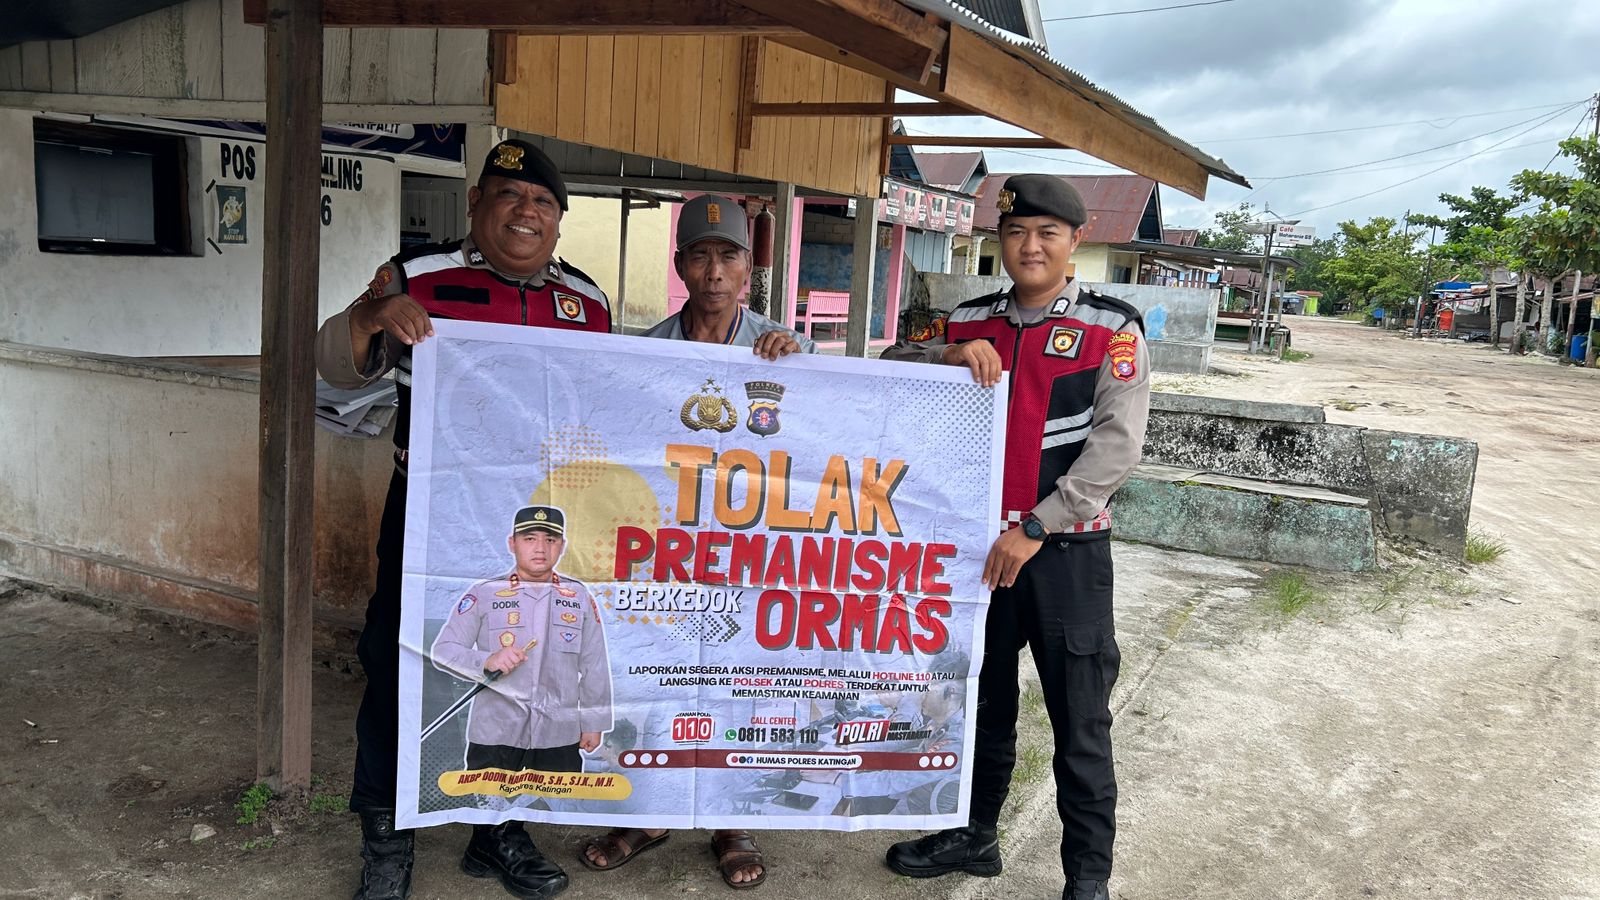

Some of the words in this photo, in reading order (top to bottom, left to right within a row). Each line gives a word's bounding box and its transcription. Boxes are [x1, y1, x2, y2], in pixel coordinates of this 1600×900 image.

[220, 142, 256, 180] POS
[665, 443, 909, 537] TOLAK
[613, 526, 957, 596] PREMANISME
[492, 600, 520, 610] DODIK
[555, 598, 581, 610] POLRI
[614, 587, 744, 613] BERKEDOK
[755, 589, 952, 655] ORMAS
[628, 666, 687, 675] LAPORKAN
[688, 666, 729, 675] SEGERA
[730, 666, 755, 675] AKSI
[756, 667, 826, 678] PREMANISME,
[828, 668, 871, 679] MELALUI
[872, 671, 914, 681] HOTLINE
[915, 672, 931, 681] 110
[931, 672, 955, 680] ATAU
[659, 677, 717, 687] LANGSUNG
[718, 677, 732, 686] KE
[733, 678, 773, 687] POLSEK
[774, 678, 802, 687] ATAU
[803, 679, 844, 689] POLRES
[845, 681, 898, 691] TERDEKAT
[898, 683, 930, 692] UNTUK
[731, 689, 800, 698] MEMASTIKAN
[801, 690, 860, 701] KEAMANAN
[750, 716, 768, 725] CALL
[769, 717, 797, 726] CENTER
[888, 722, 912, 731] UNTUK
[673, 720, 711, 739] 110
[738, 727, 767, 742] 0811
[770, 728, 795, 743] 583
[800, 729, 819, 744] 110
[839, 721, 884, 743] POLRI
[887, 730, 932, 741] MASYARAKAT
[756, 757, 786, 765] HUMAS
[787, 757, 817, 765] POLRES
[818, 757, 856, 765] KATINGAN
[457, 773, 481, 785] AKBP
[481, 771, 507, 783] DODIK
[508, 772, 546, 785] HARTONO,
[499, 783, 534, 794] Kapolres
[535, 784, 572, 794] Katingan
